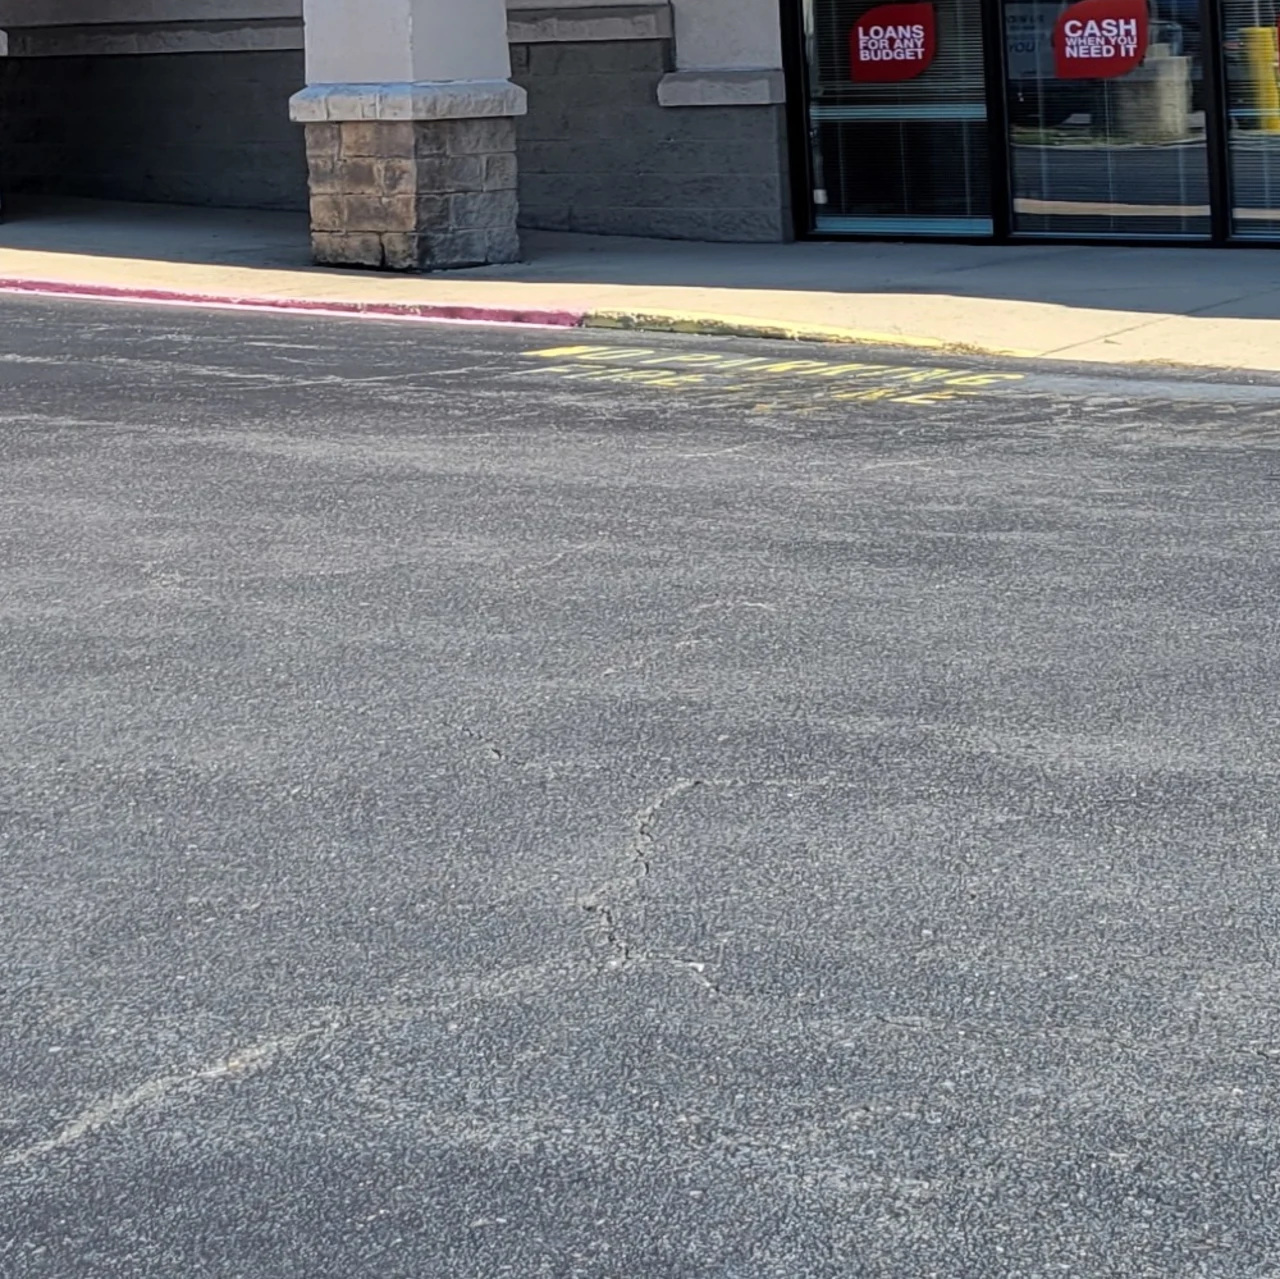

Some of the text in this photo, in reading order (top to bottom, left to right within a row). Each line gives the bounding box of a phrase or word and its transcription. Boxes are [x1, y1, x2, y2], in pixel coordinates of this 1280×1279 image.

[858, 25, 925, 40] LOANS
[1064, 18, 1137, 37] CASH
[859, 38, 924, 50] FOR ANY
[1065, 35, 1137, 46] WHEN YOU
[859, 48, 925, 61] BUDGET
[1065, 44, 1137, 58] NEED IT
[520, 345, 1027, 386] NO PARKING
